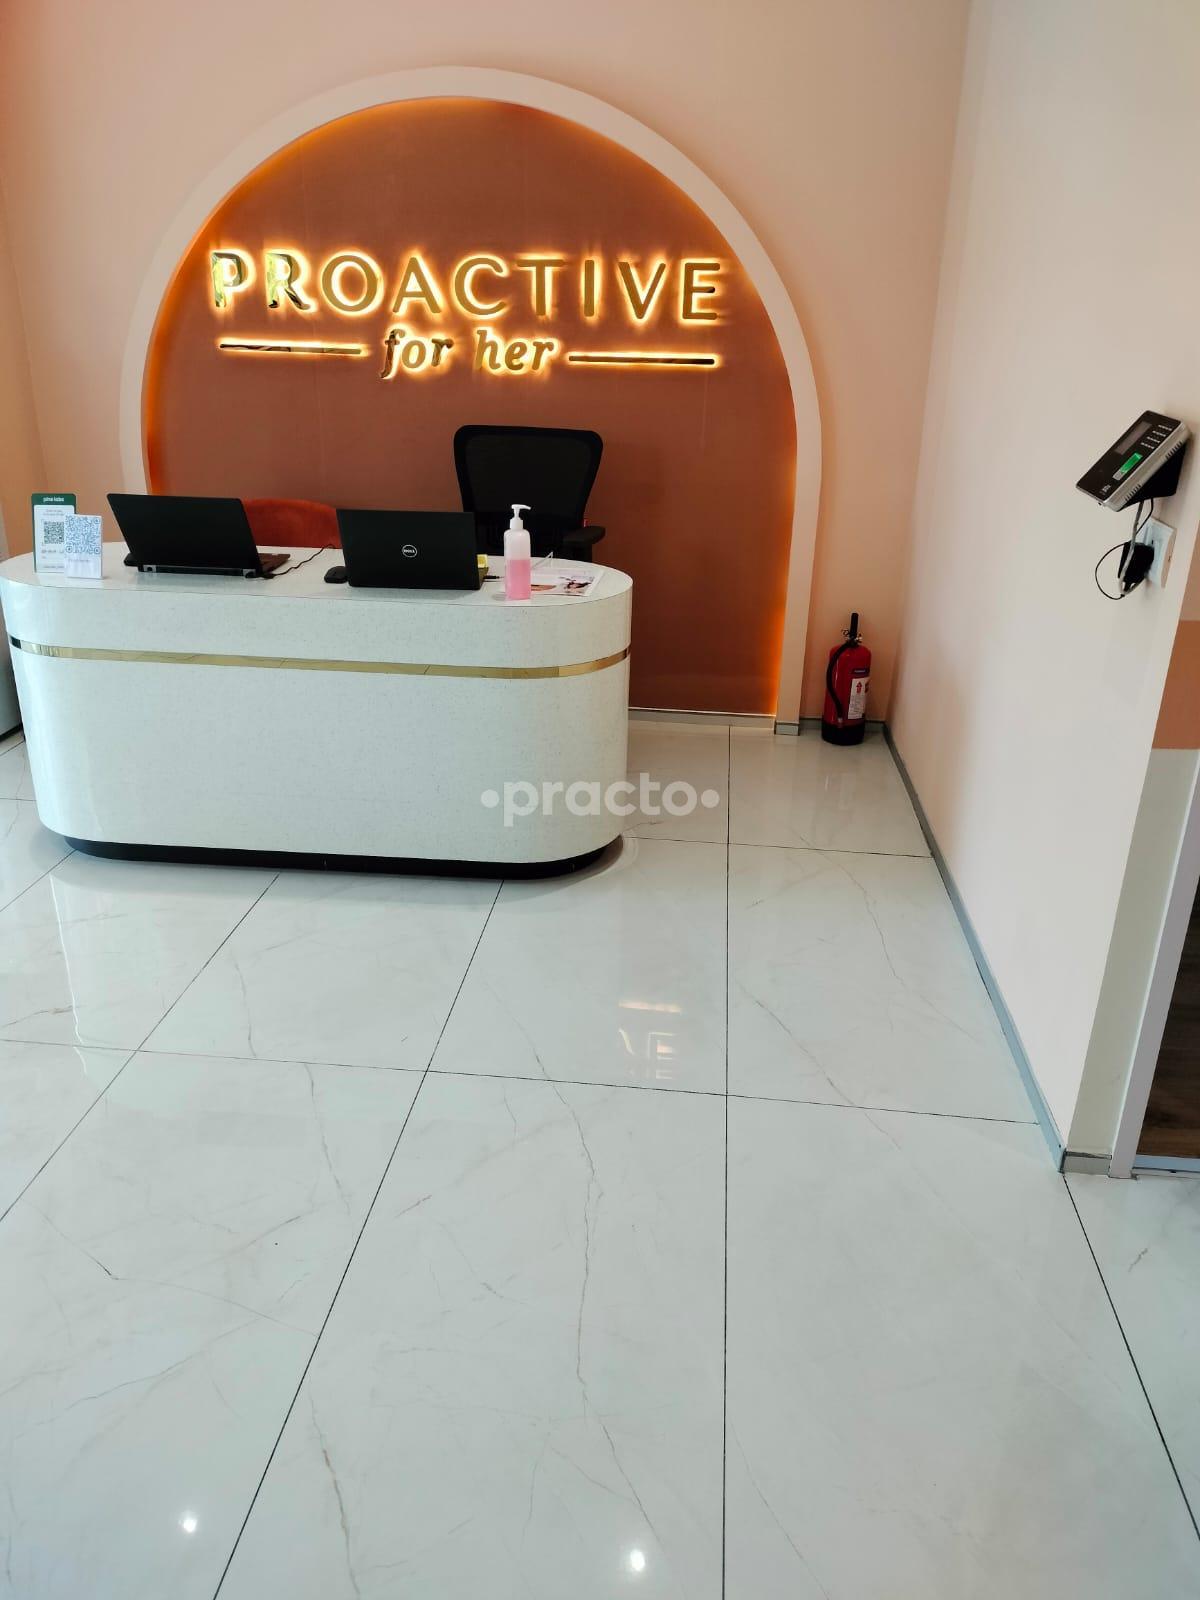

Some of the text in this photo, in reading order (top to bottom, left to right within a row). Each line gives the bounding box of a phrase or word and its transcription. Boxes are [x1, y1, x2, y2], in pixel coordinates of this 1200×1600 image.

[211, 251, 721, 320] PROACTIVE
[381, 328, 555, 379] for her
